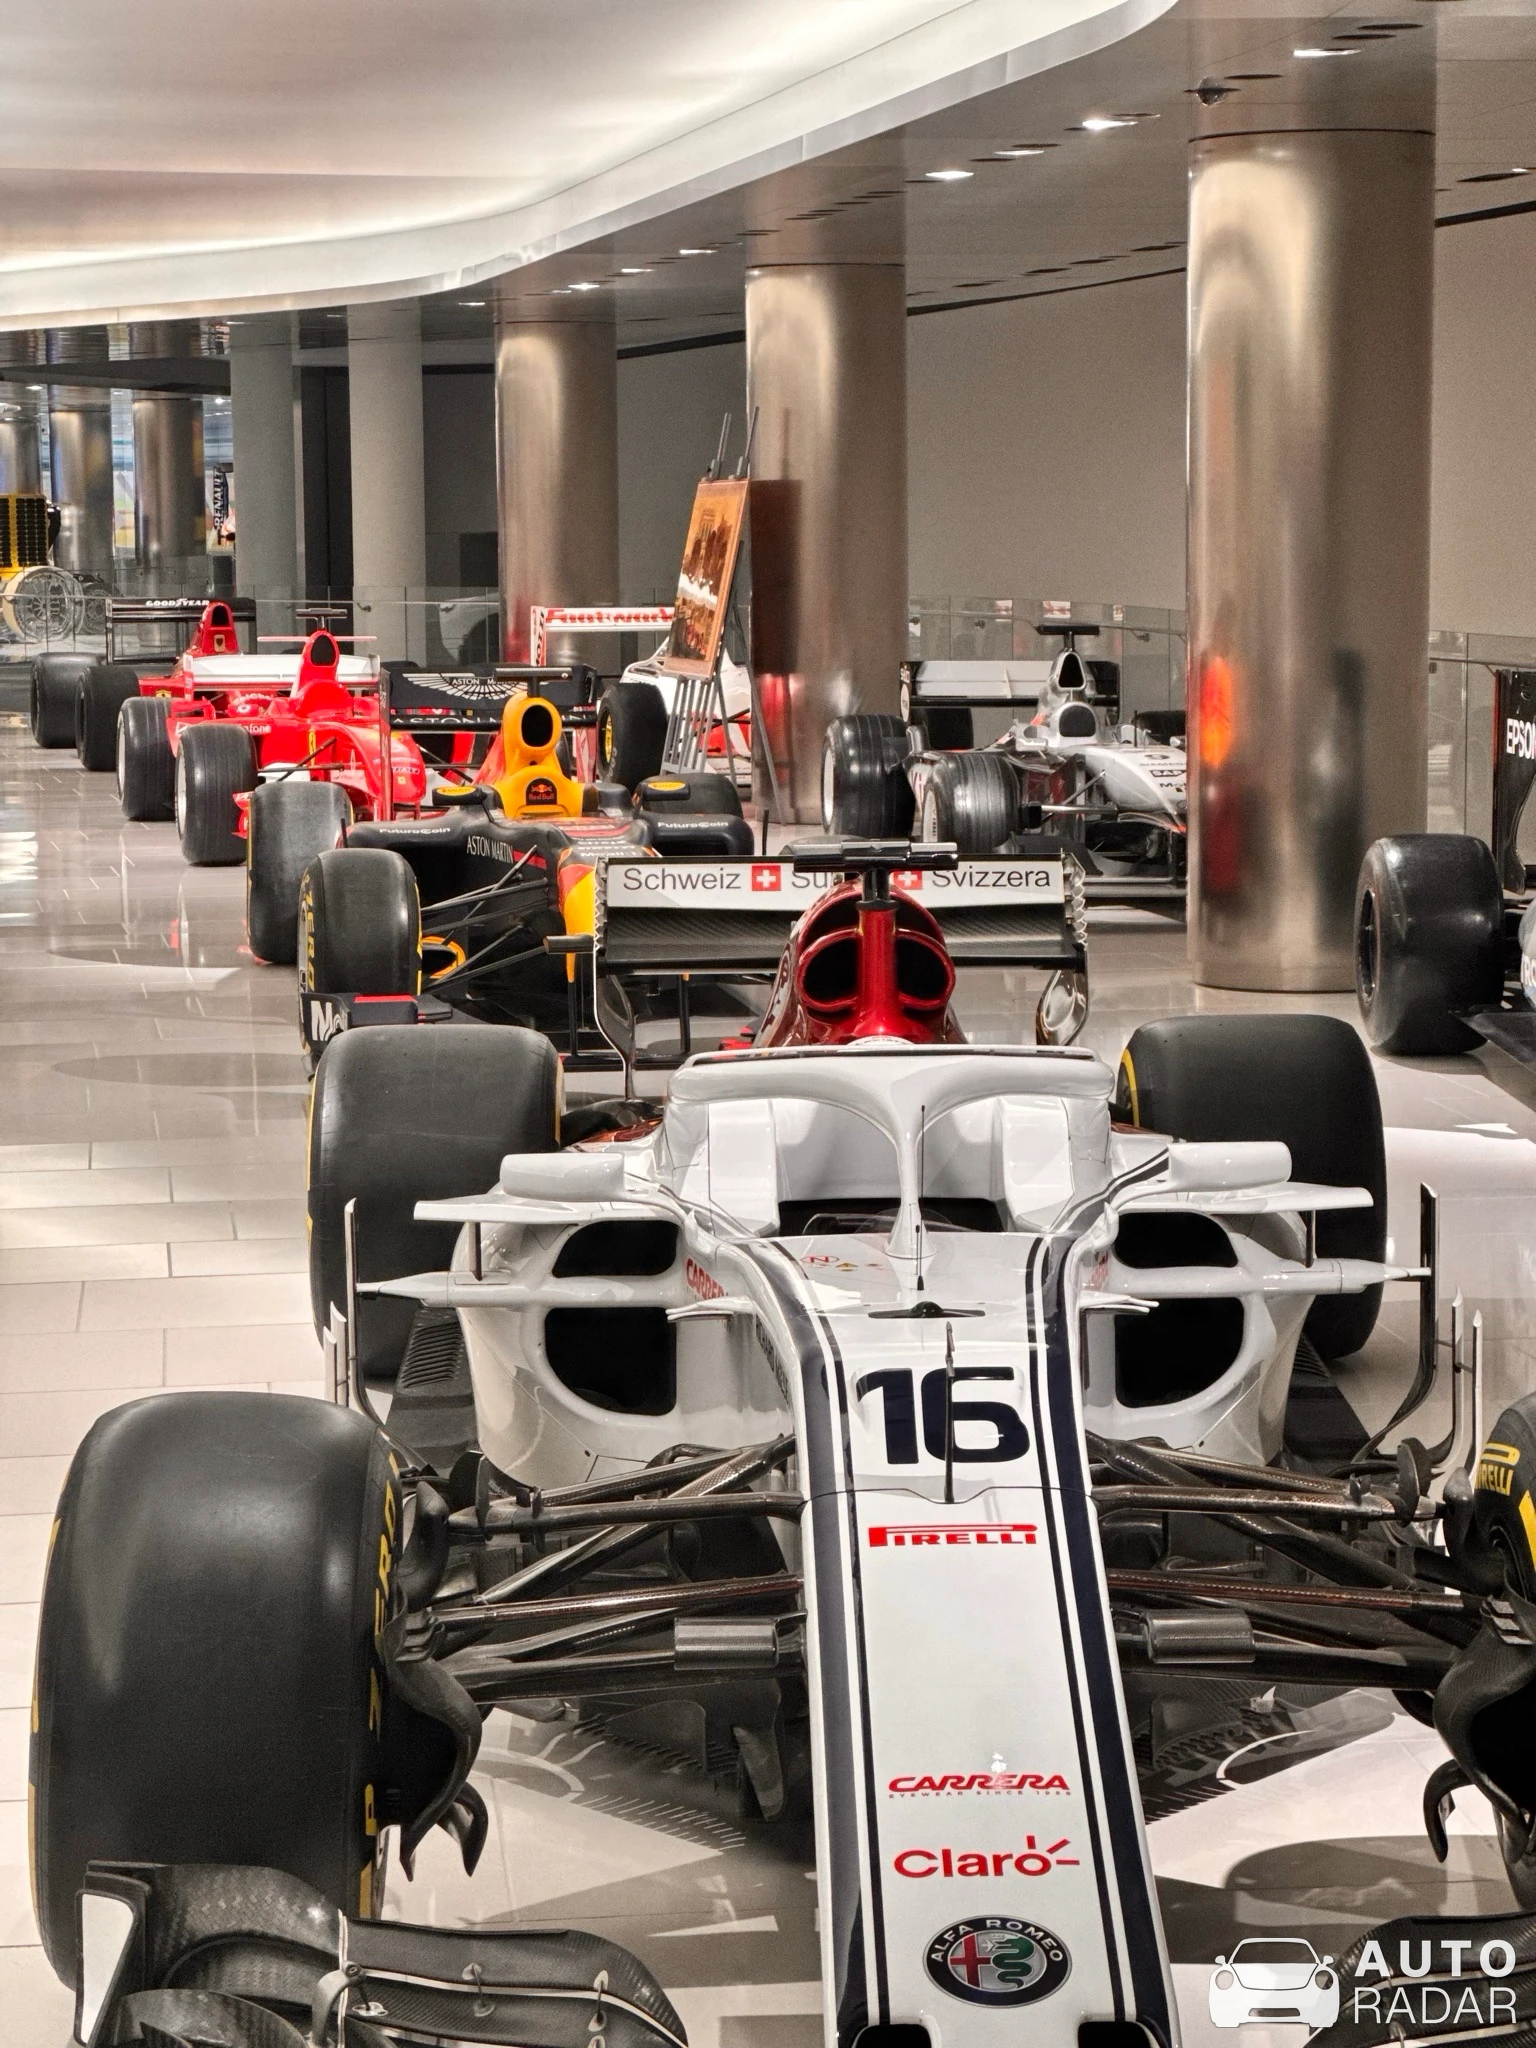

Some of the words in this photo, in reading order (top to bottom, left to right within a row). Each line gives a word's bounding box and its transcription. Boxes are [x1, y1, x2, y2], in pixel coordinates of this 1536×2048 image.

[213, 469, 225, 530] RENAULT
[145, 598, 210, 607] GOODYEAR
[452, 677, 480, 686] ASTON
[466, 835, 491, 857] ASTON
[491, 840, 514, 865] MARTIN
[623, 867, 741, 891] Schweiz
[932, 865, 1050, 888] Svizzera
[856, 1366, 1030, 1465] 16
[868, 1524, 1038, 1548] PIRELLI
[888, 1774, 1070, 1792] CARRERA
[889, 1791, 964, 1799] EYEWEAR
[894, 1838, 1054, 1879] Claro
[931, 1924, 974, 1963] ALFA
[985, 1919, 1064, 1962] ROMEO
